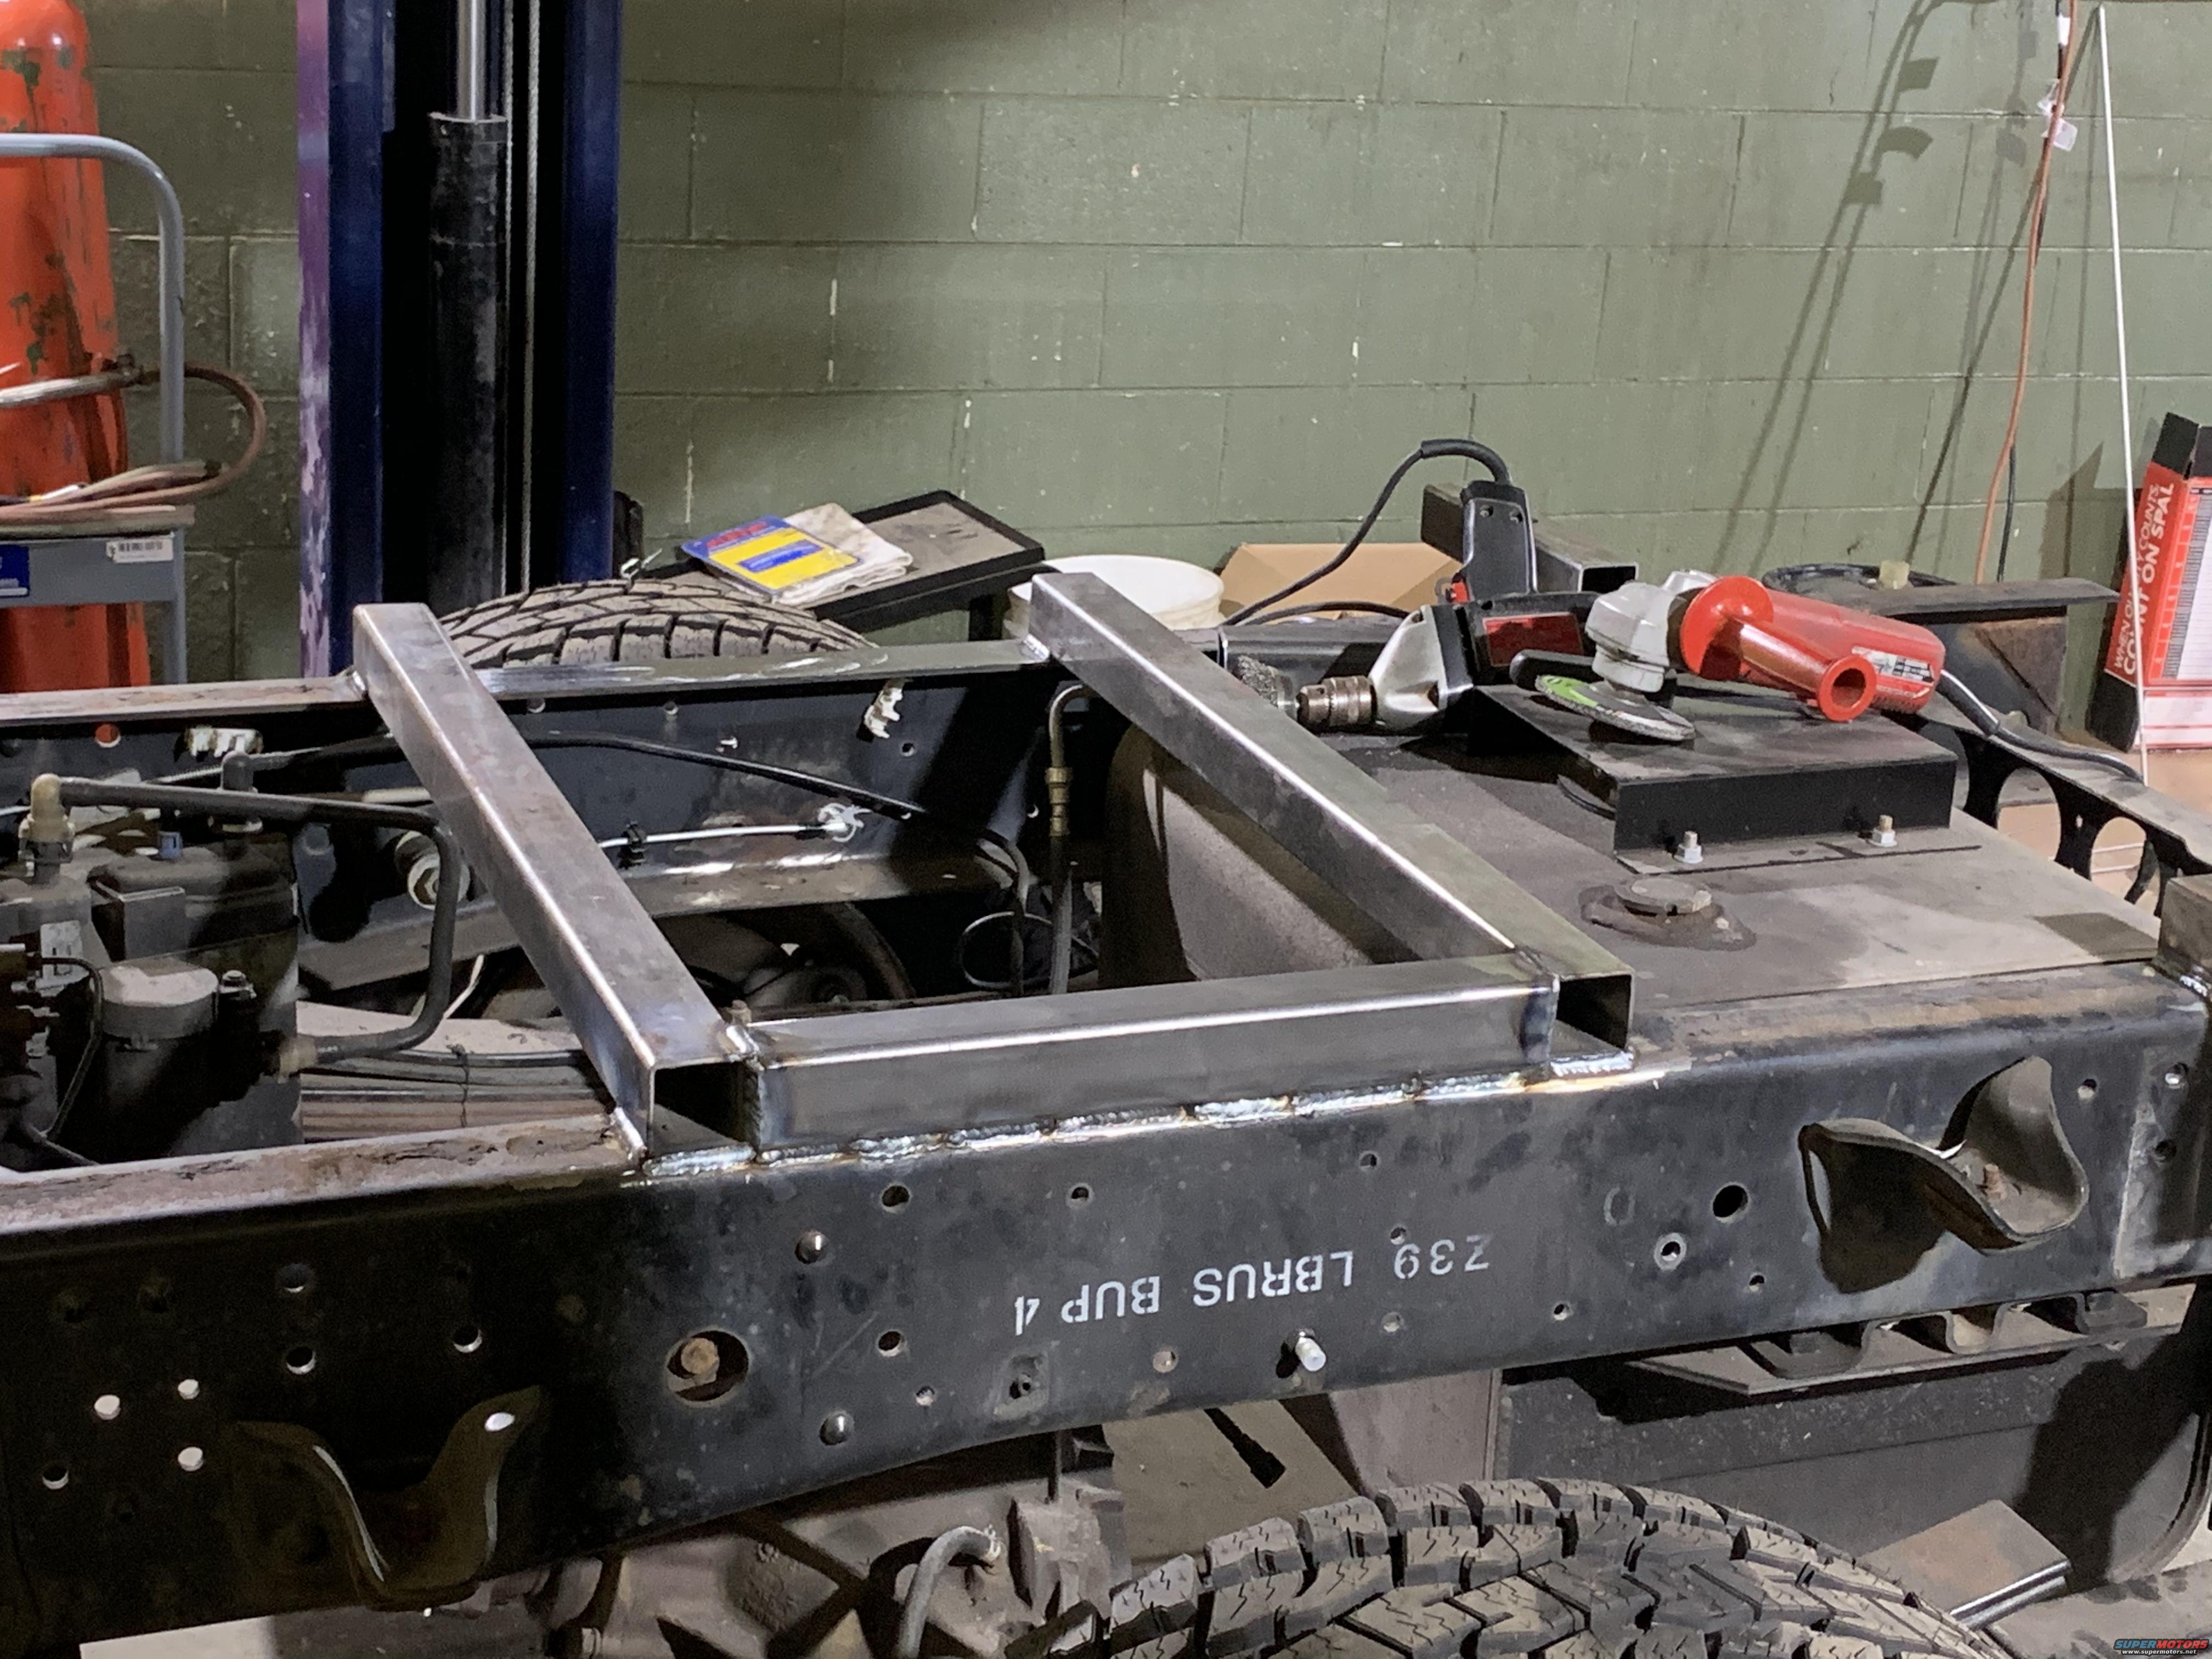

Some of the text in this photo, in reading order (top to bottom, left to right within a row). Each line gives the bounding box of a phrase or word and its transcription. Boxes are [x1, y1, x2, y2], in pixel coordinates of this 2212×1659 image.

[2142, 543, 2160, 584] ON
[2151, 483, 2174, 539] SPAL
[2114, 619, 2131, 668] WHEN
[1061, 1276, 1160, 1323] BUP
[1193, 1250, 1353, 1307] LBRUS
[1014, 1296, 1040, 1336] 4
